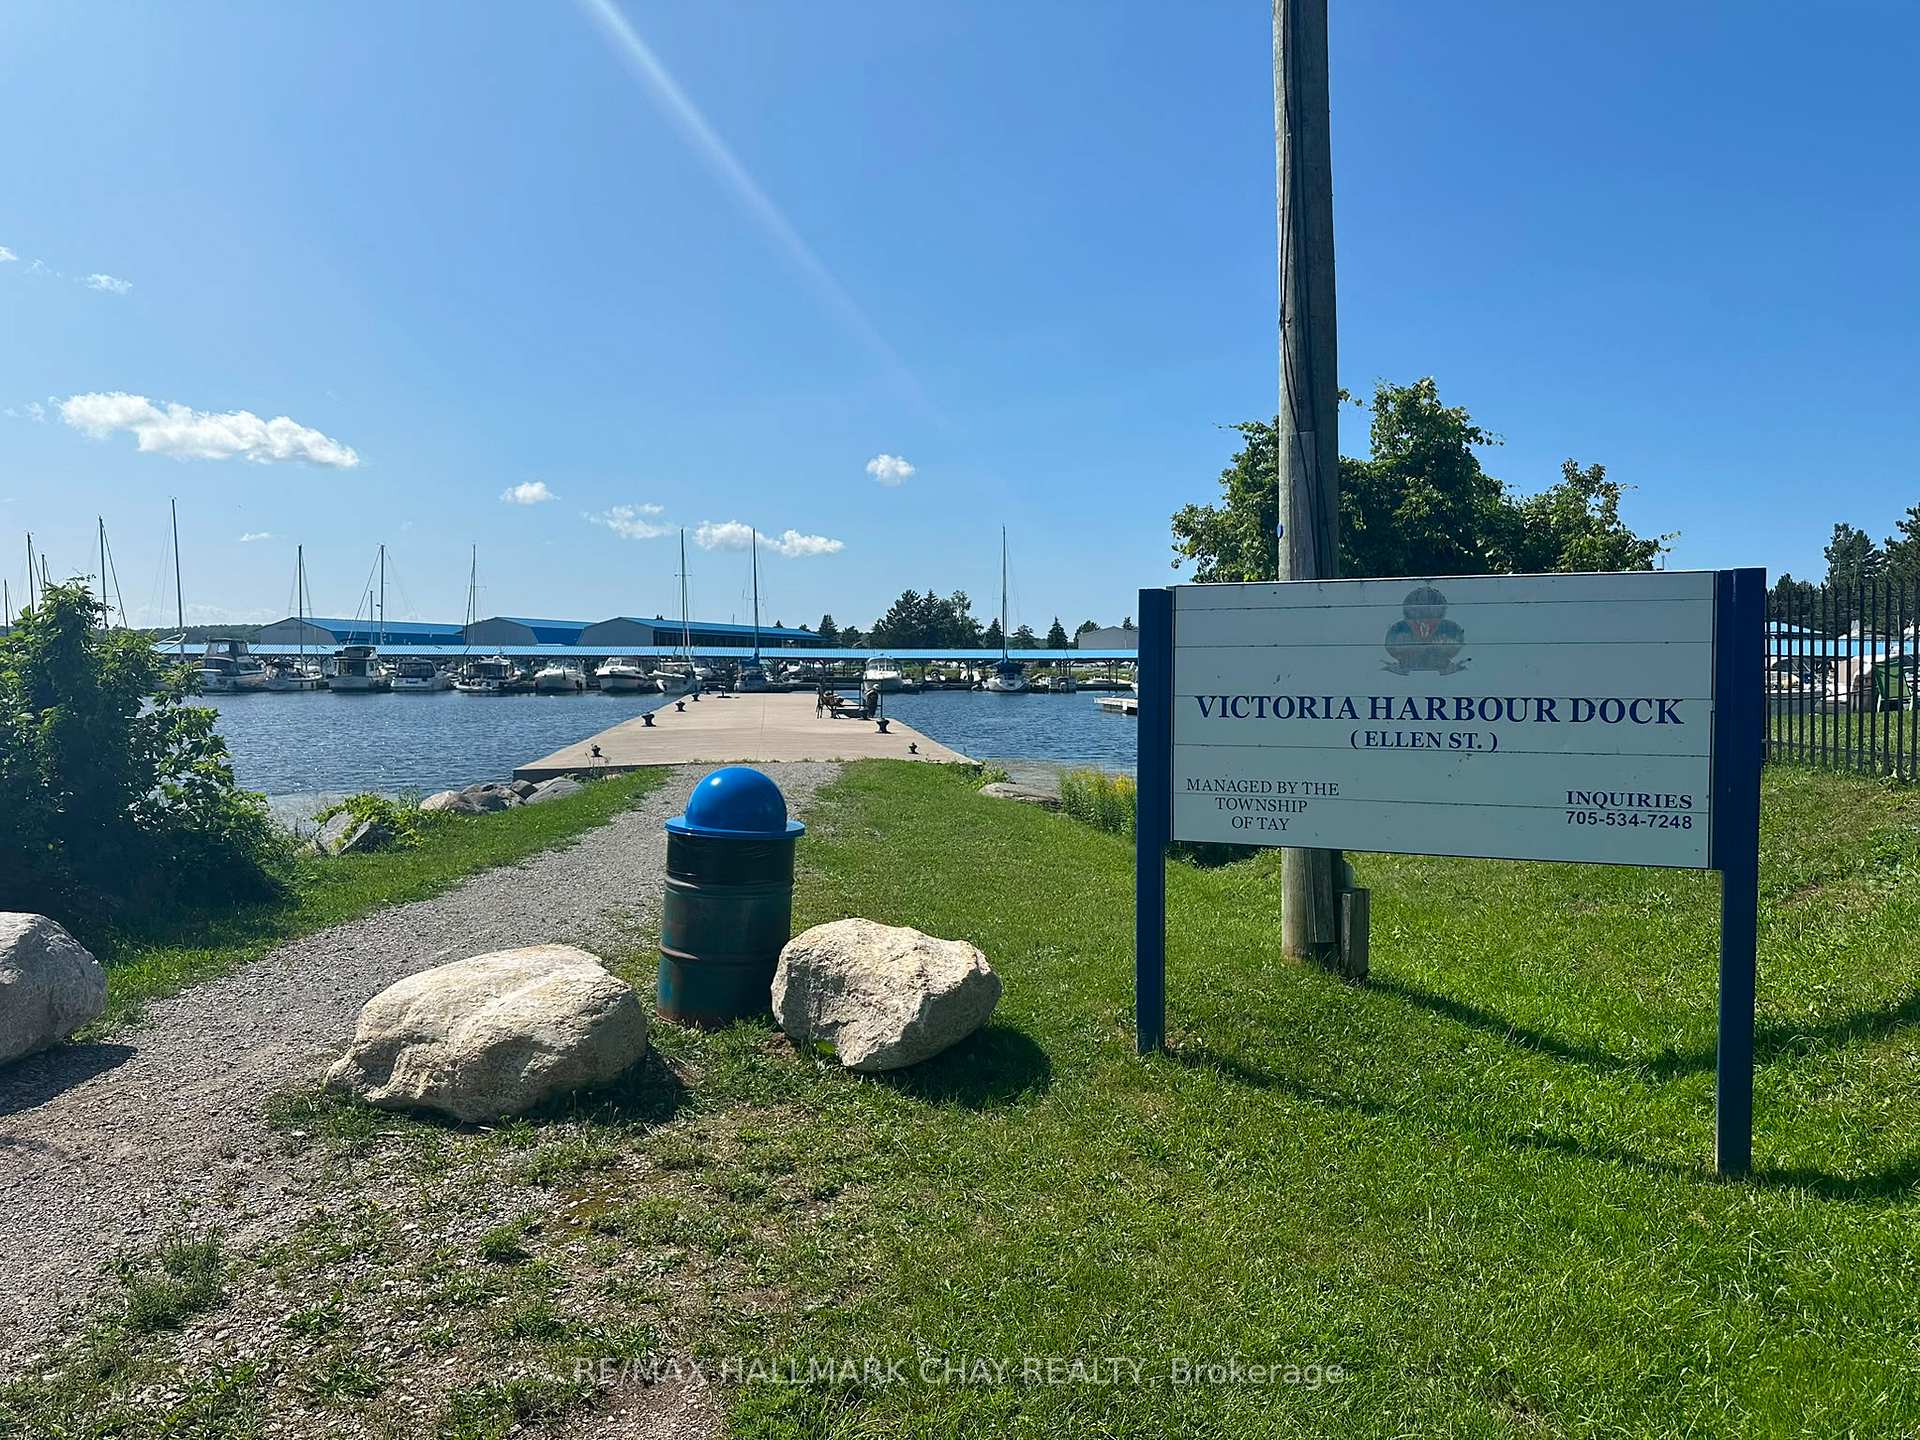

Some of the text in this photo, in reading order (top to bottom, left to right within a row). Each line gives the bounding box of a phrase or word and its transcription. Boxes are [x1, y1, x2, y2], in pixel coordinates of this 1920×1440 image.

[1194, 695, 1685, 725] VICTORIA HARBOUR DOCK
[1186, 778, 1340, 796] MANAGED BY THE
[1215, 797, 1308, 813] TOWNSHIP
[1565, 790, 1693, 809] INQUIRIES
[1231, 815, 1291, 831] OF TAY
[1565, 810, 1693, 829] 705-534-7248
